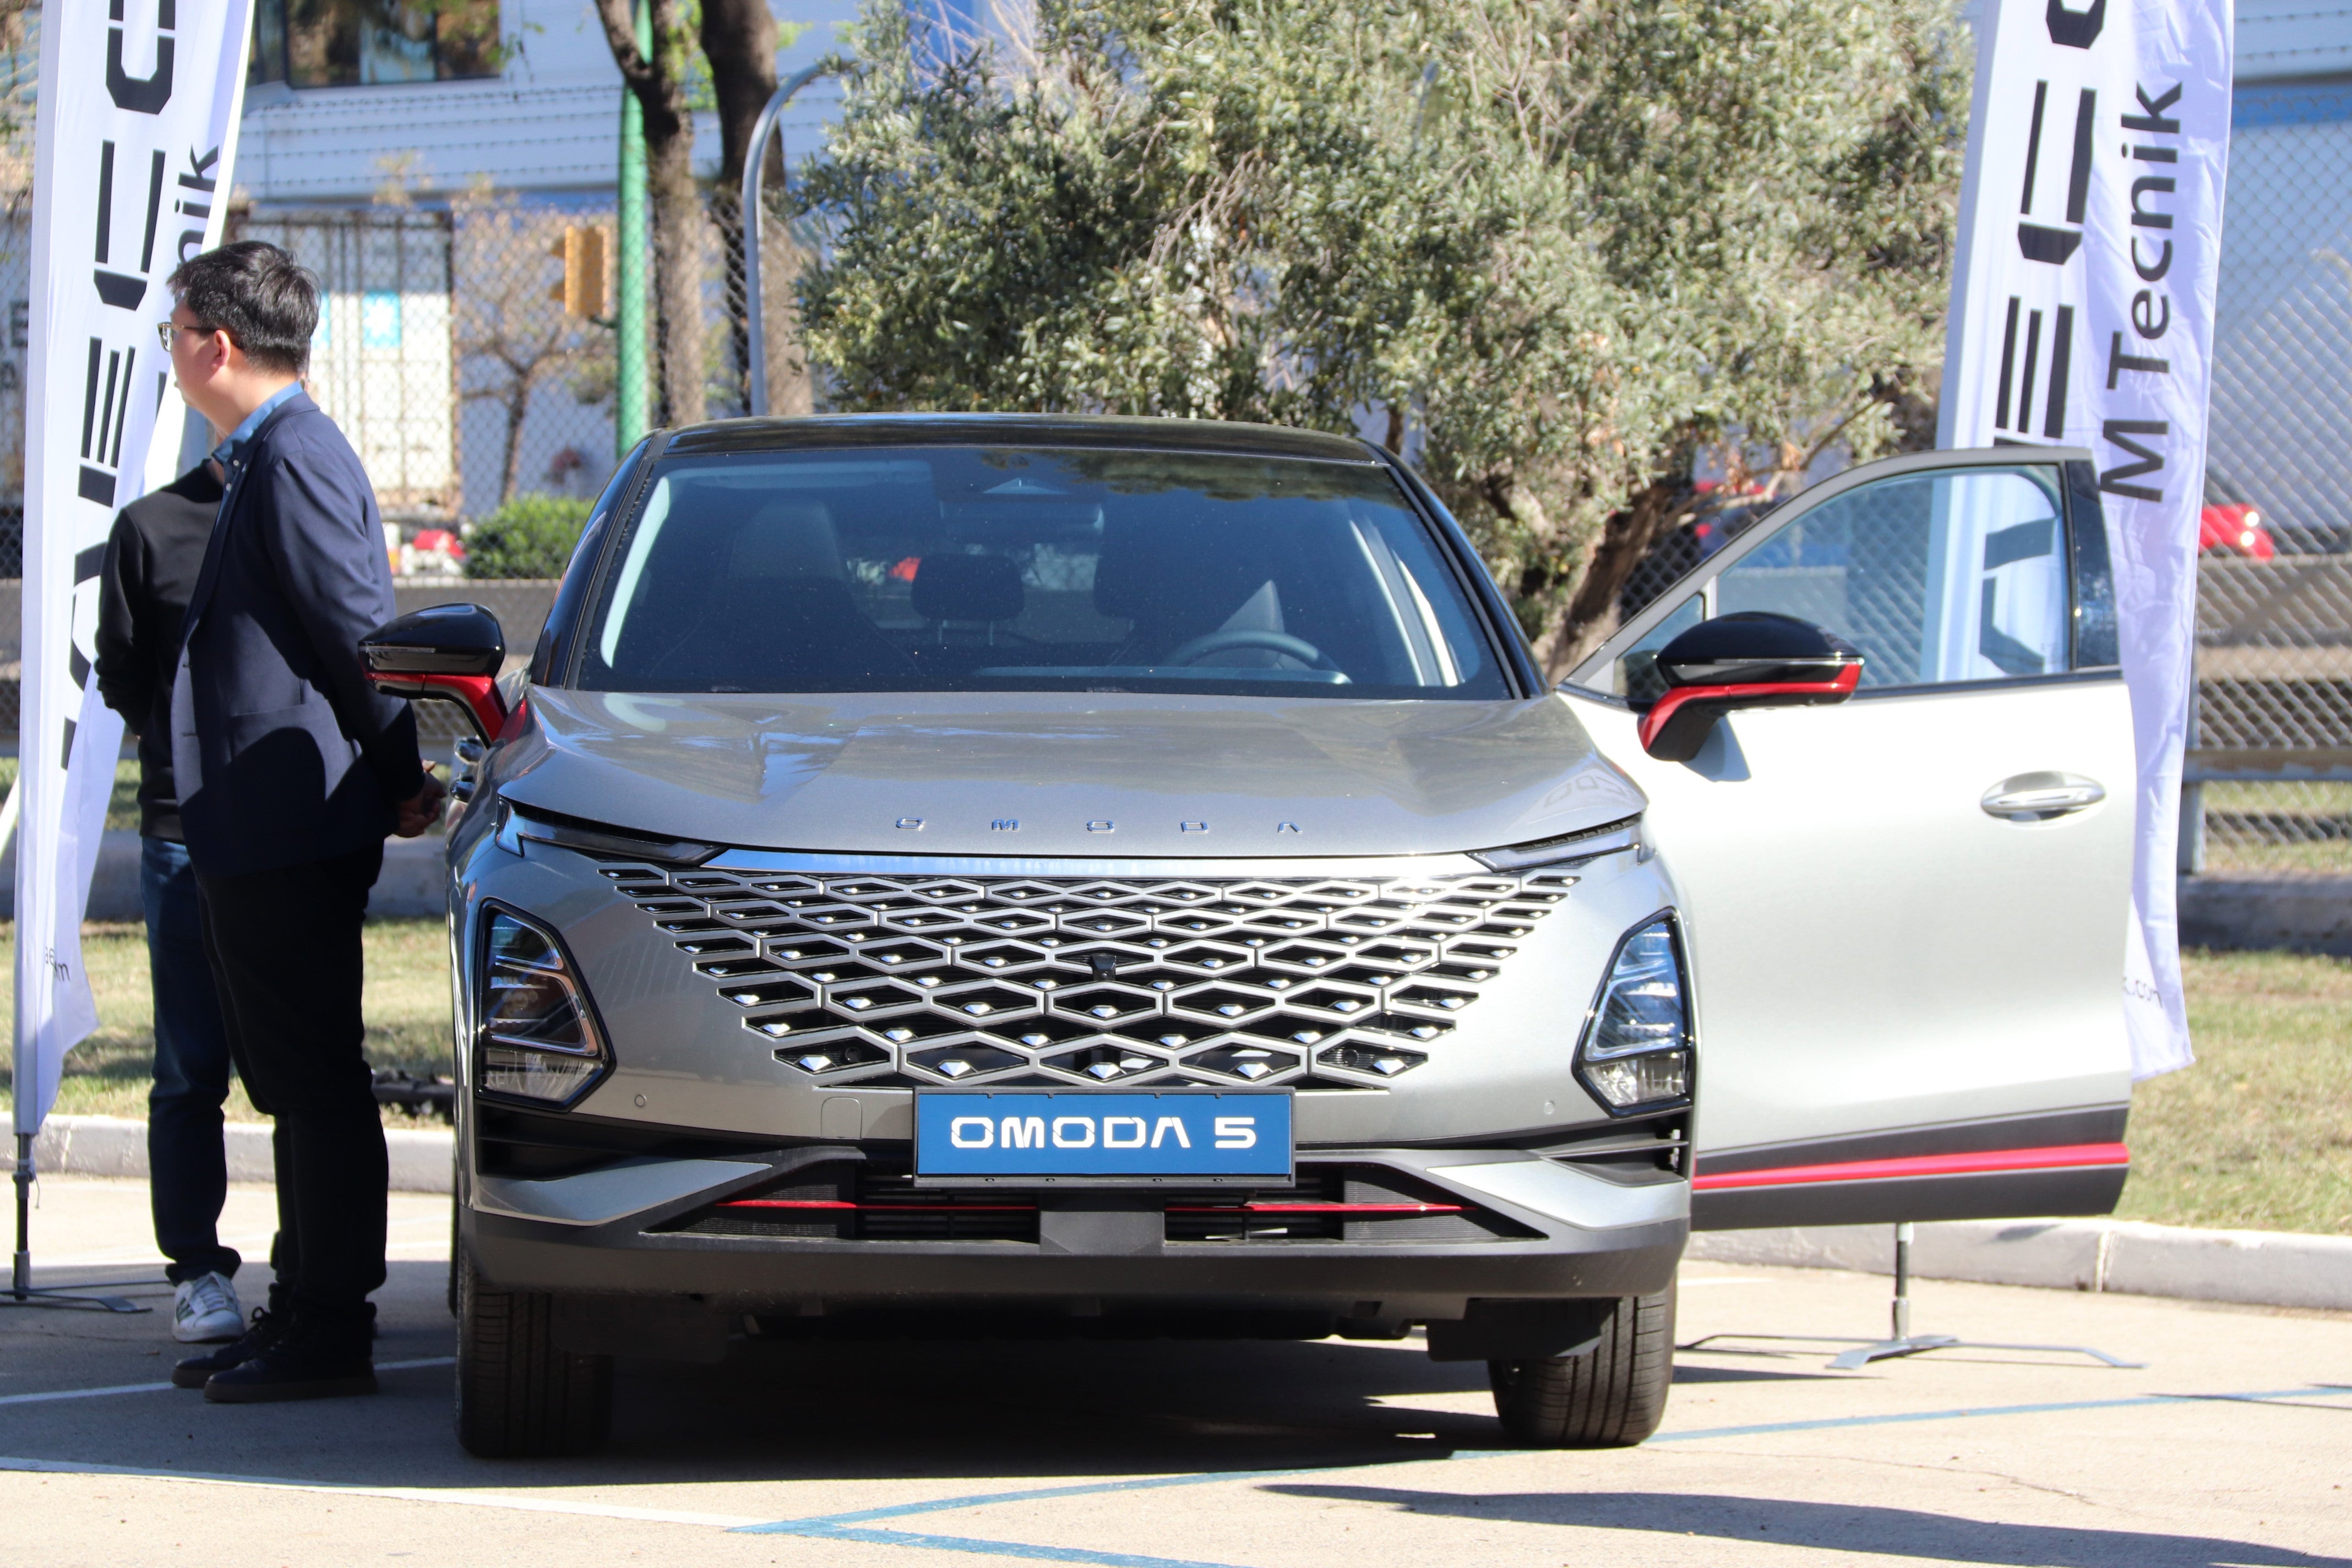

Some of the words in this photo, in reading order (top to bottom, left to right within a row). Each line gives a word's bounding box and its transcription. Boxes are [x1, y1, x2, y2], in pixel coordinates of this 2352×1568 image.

[2106, 81, 2183, 390] Tecnik
[2099, 418, 2169, 503] M
[895, 817, 1303, 834] OMODA
[951, 1117, 1191, 1148] OMODA
[1215, 1117, 1257, 1148] 5
